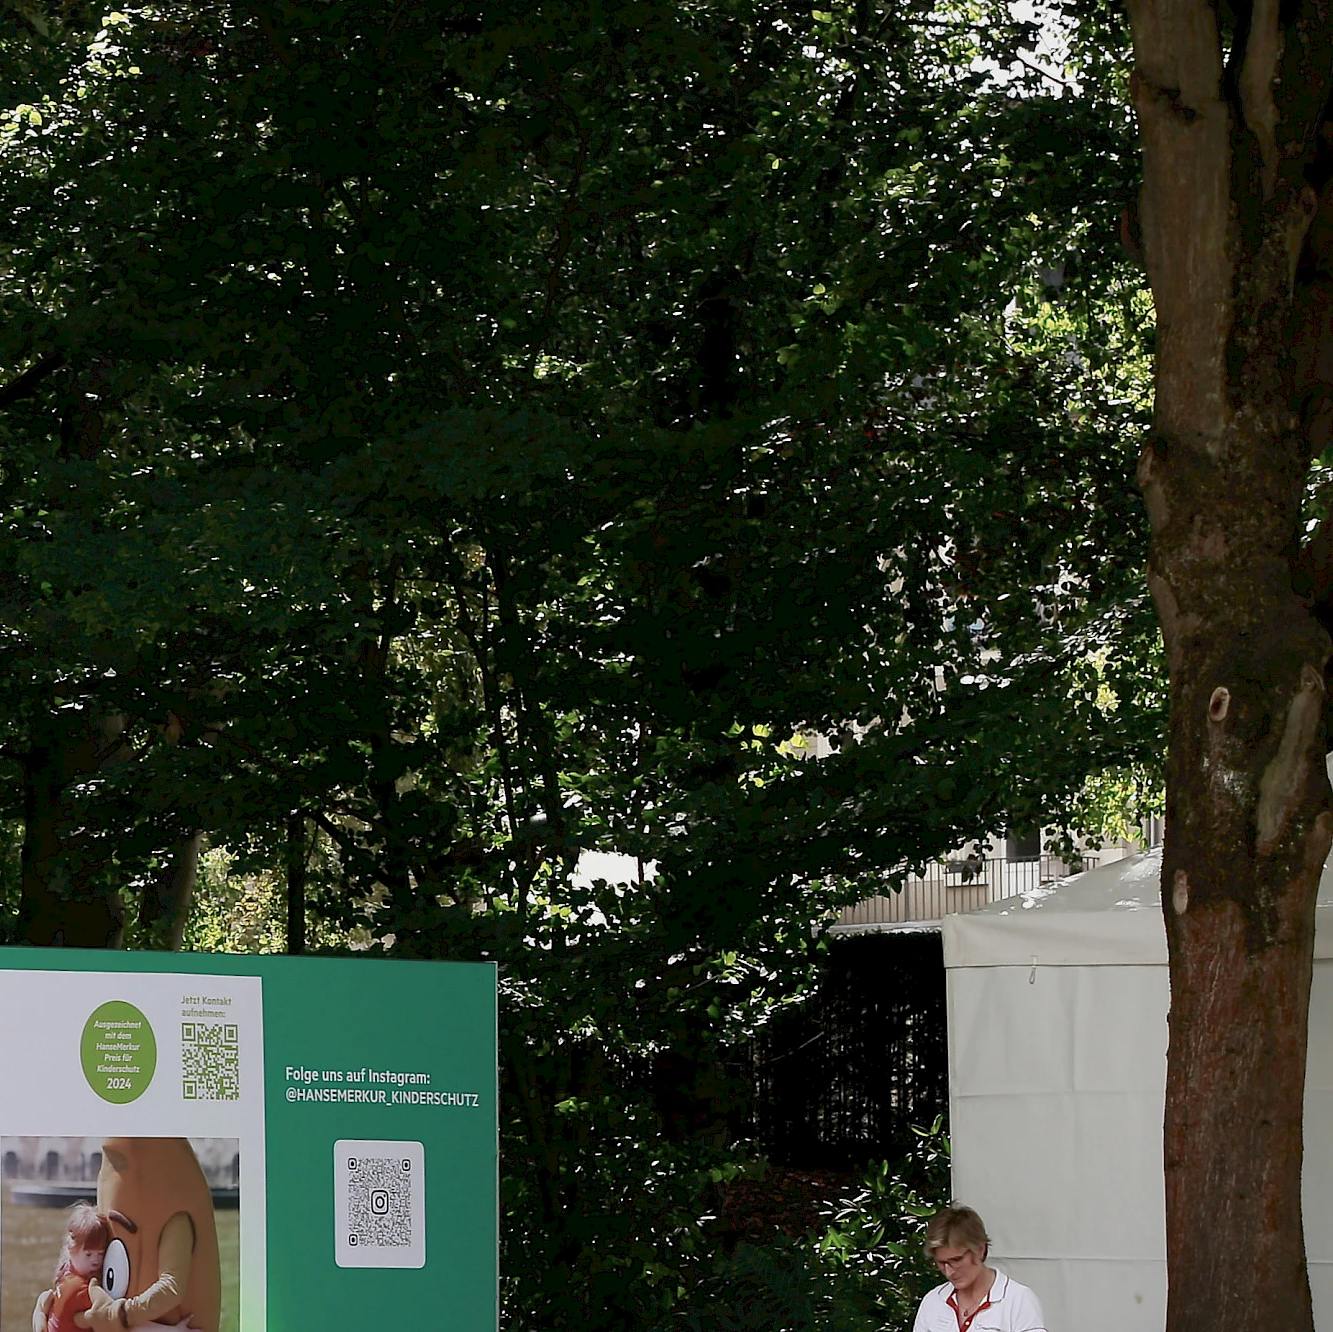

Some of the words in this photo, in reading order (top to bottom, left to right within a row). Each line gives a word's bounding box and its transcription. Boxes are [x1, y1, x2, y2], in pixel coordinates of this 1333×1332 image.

[181, 996, 200, 1005] Jetzt
[202, 997, 231, 1006] Kontakt
[181, 1008, 225, 1018] aufnehmen:
[96, 1042, 140, 1051] HanseMerkur
[96, 1065, 140, 1073] Kinderschutz
[285, 1067, 319, 1085] Folge
[322, 1070, 343, 1082] uns
[347, 1068, 365, 1083] auf
[368, 1069, 430, 1087] Instagram:
[107, 1077, 132, 1090] 2024
[285, 1088, 478, 1107] @HANSEMERKUR_KINDERSCHUTZ
